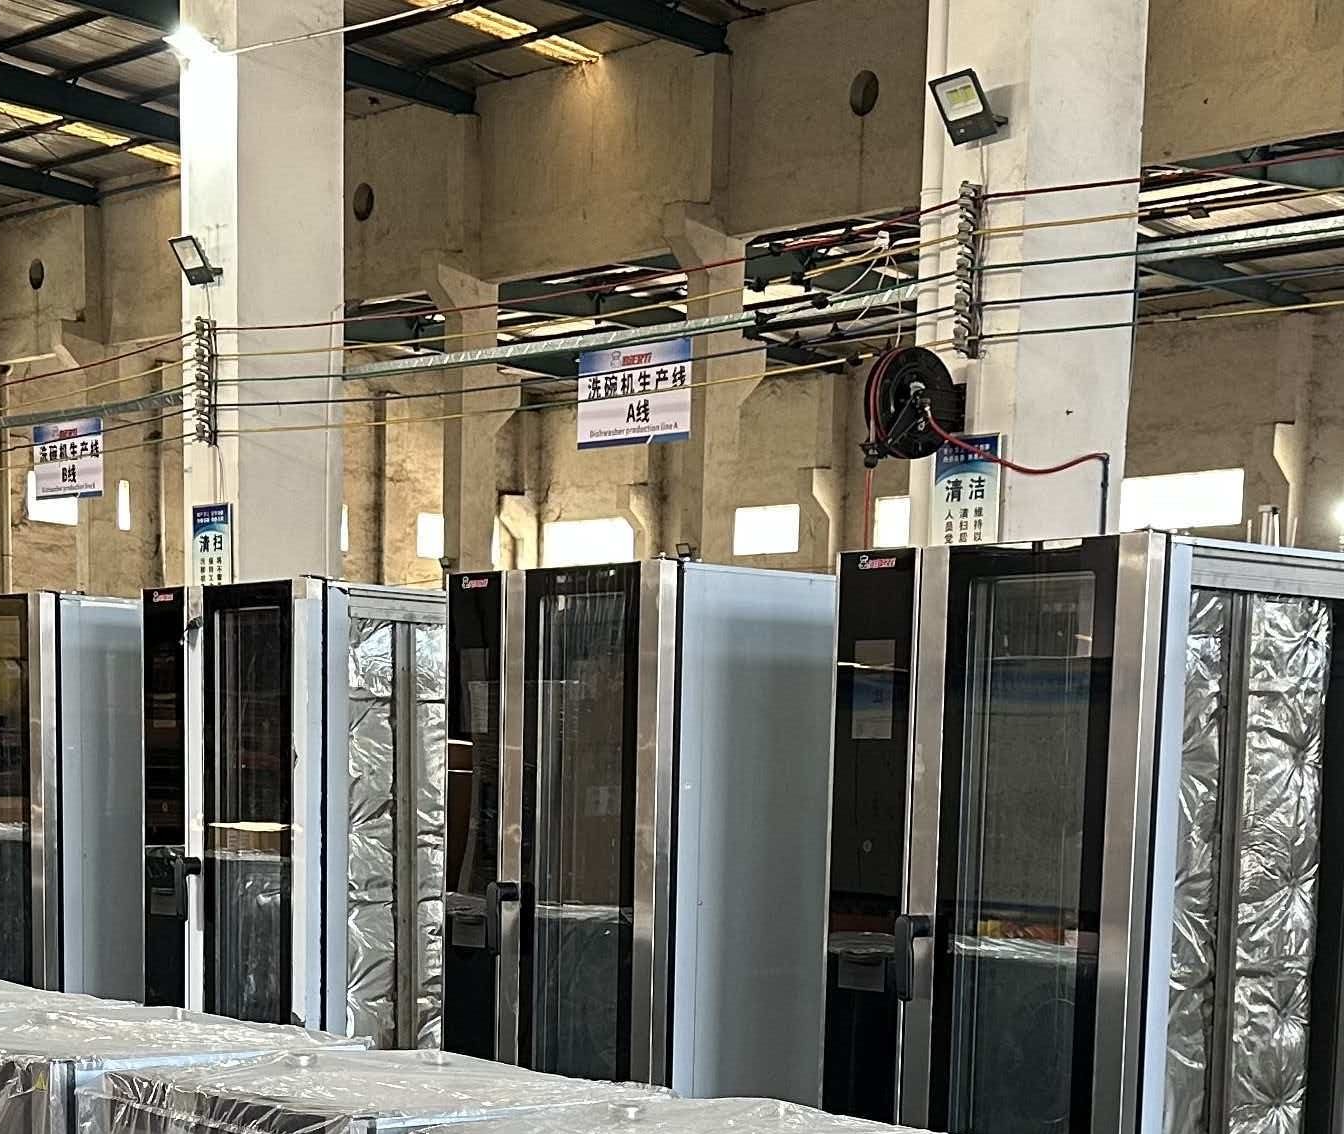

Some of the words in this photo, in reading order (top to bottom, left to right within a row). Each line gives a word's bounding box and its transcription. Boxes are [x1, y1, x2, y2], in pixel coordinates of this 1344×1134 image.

[587, 365, 687, 400] 洗碗机生产线
[626, 399, 650, 423] A线
[945, 476, 986, 503] 清洁
[199, 533, 223, 553] 清扫
